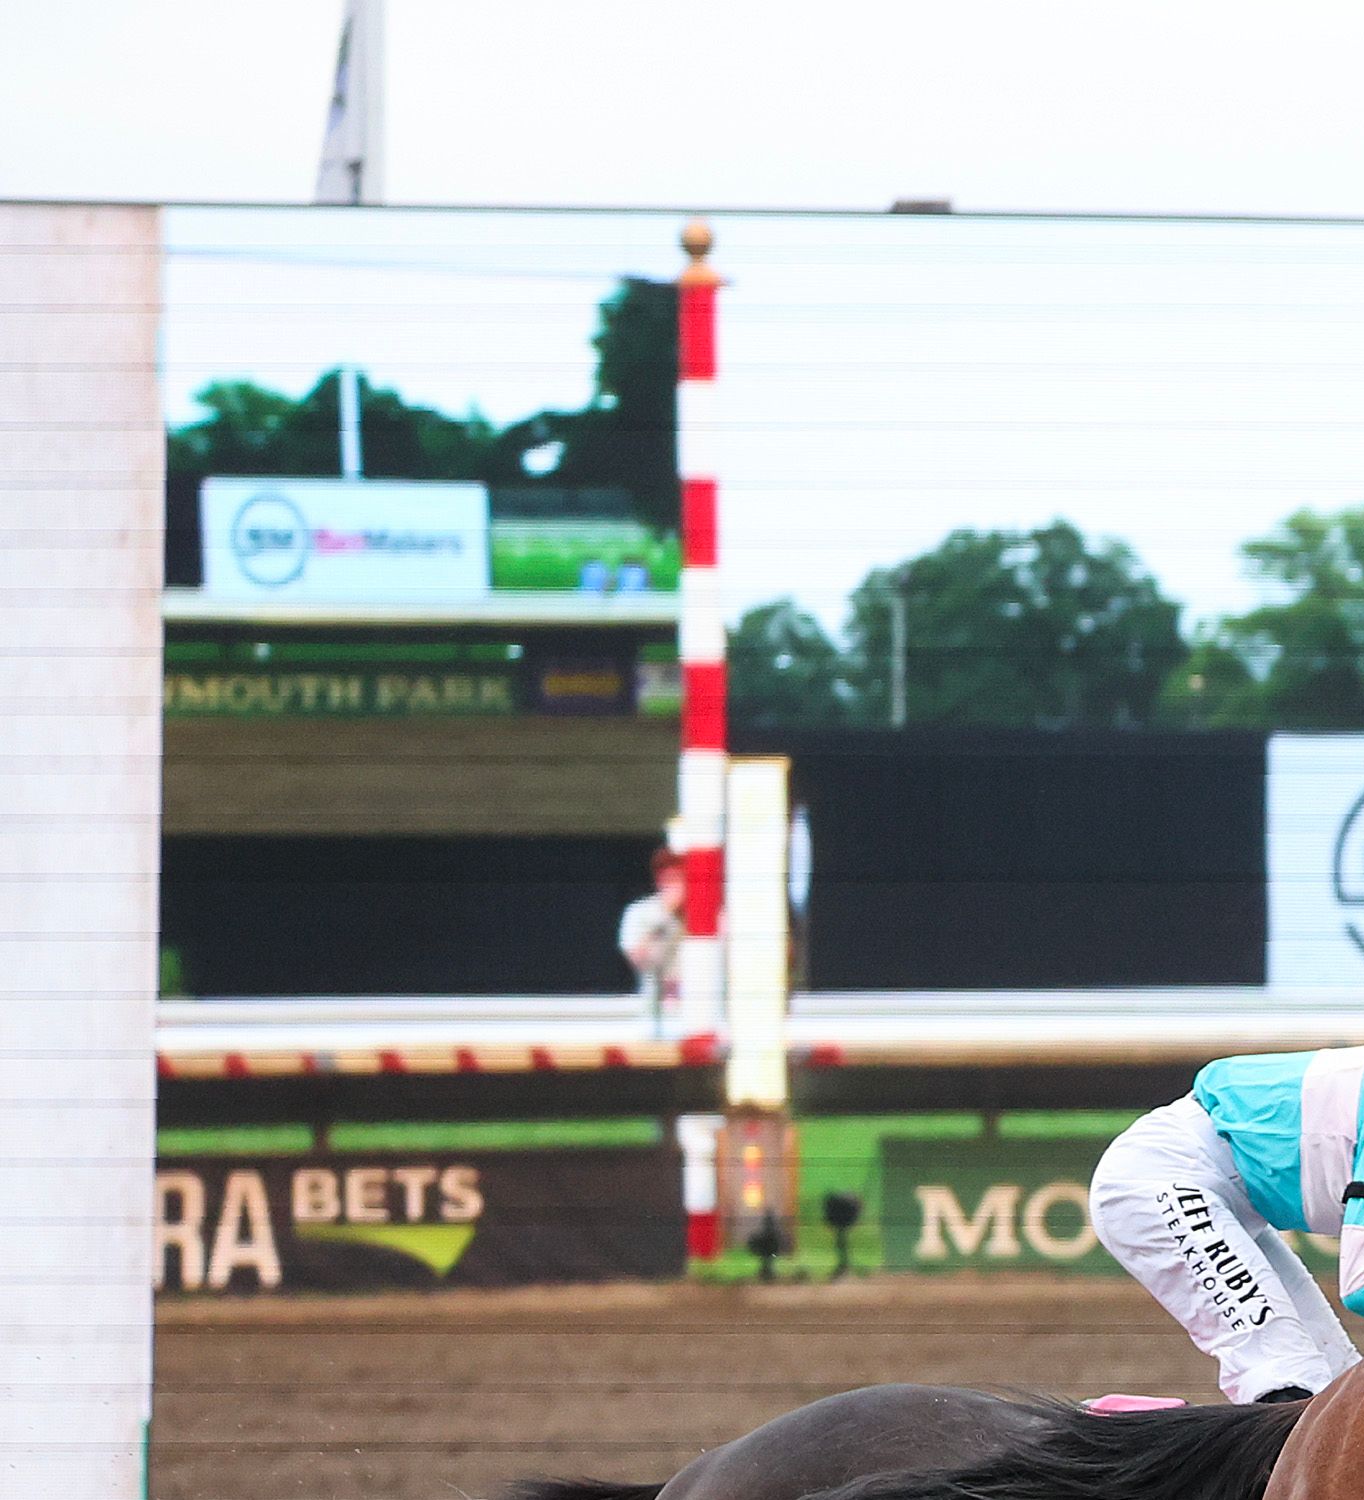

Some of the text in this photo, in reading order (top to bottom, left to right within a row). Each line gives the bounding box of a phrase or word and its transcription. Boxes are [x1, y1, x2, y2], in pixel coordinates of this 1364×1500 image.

[291, 1164, 486, 1223] BETS
[1156, 1191, 1246, 1332] STEAKHOUSE
[1172, 1183, 1276, 1326] JEFF RUBY'S
